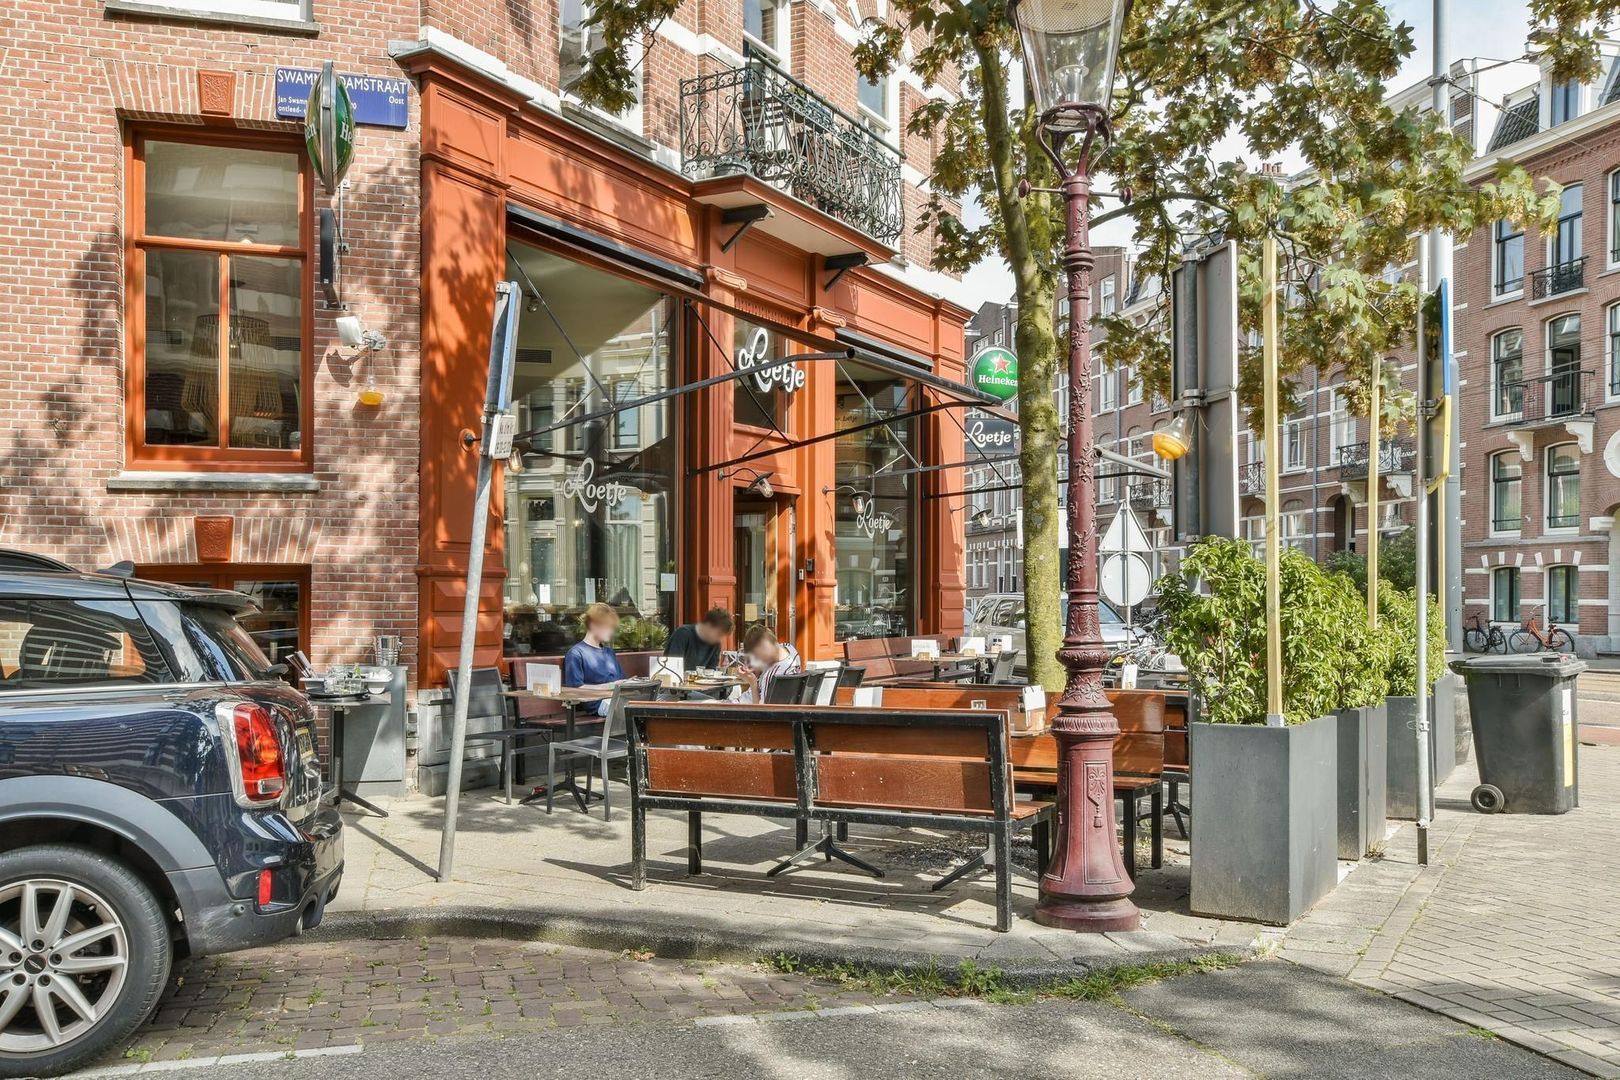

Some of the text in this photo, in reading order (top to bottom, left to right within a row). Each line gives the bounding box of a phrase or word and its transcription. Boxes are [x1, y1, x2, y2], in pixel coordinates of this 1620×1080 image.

[277, 69, 407, 95] SWAMDAMSTRAAT
[388, 96, 405, 105] Oost
[739, 327, 805, 393] Loetje
[964, 421, 1012, 448] Loetje
[563, 457, 627, 514] Loetje
[856, 498, 892, 539] Loetje
